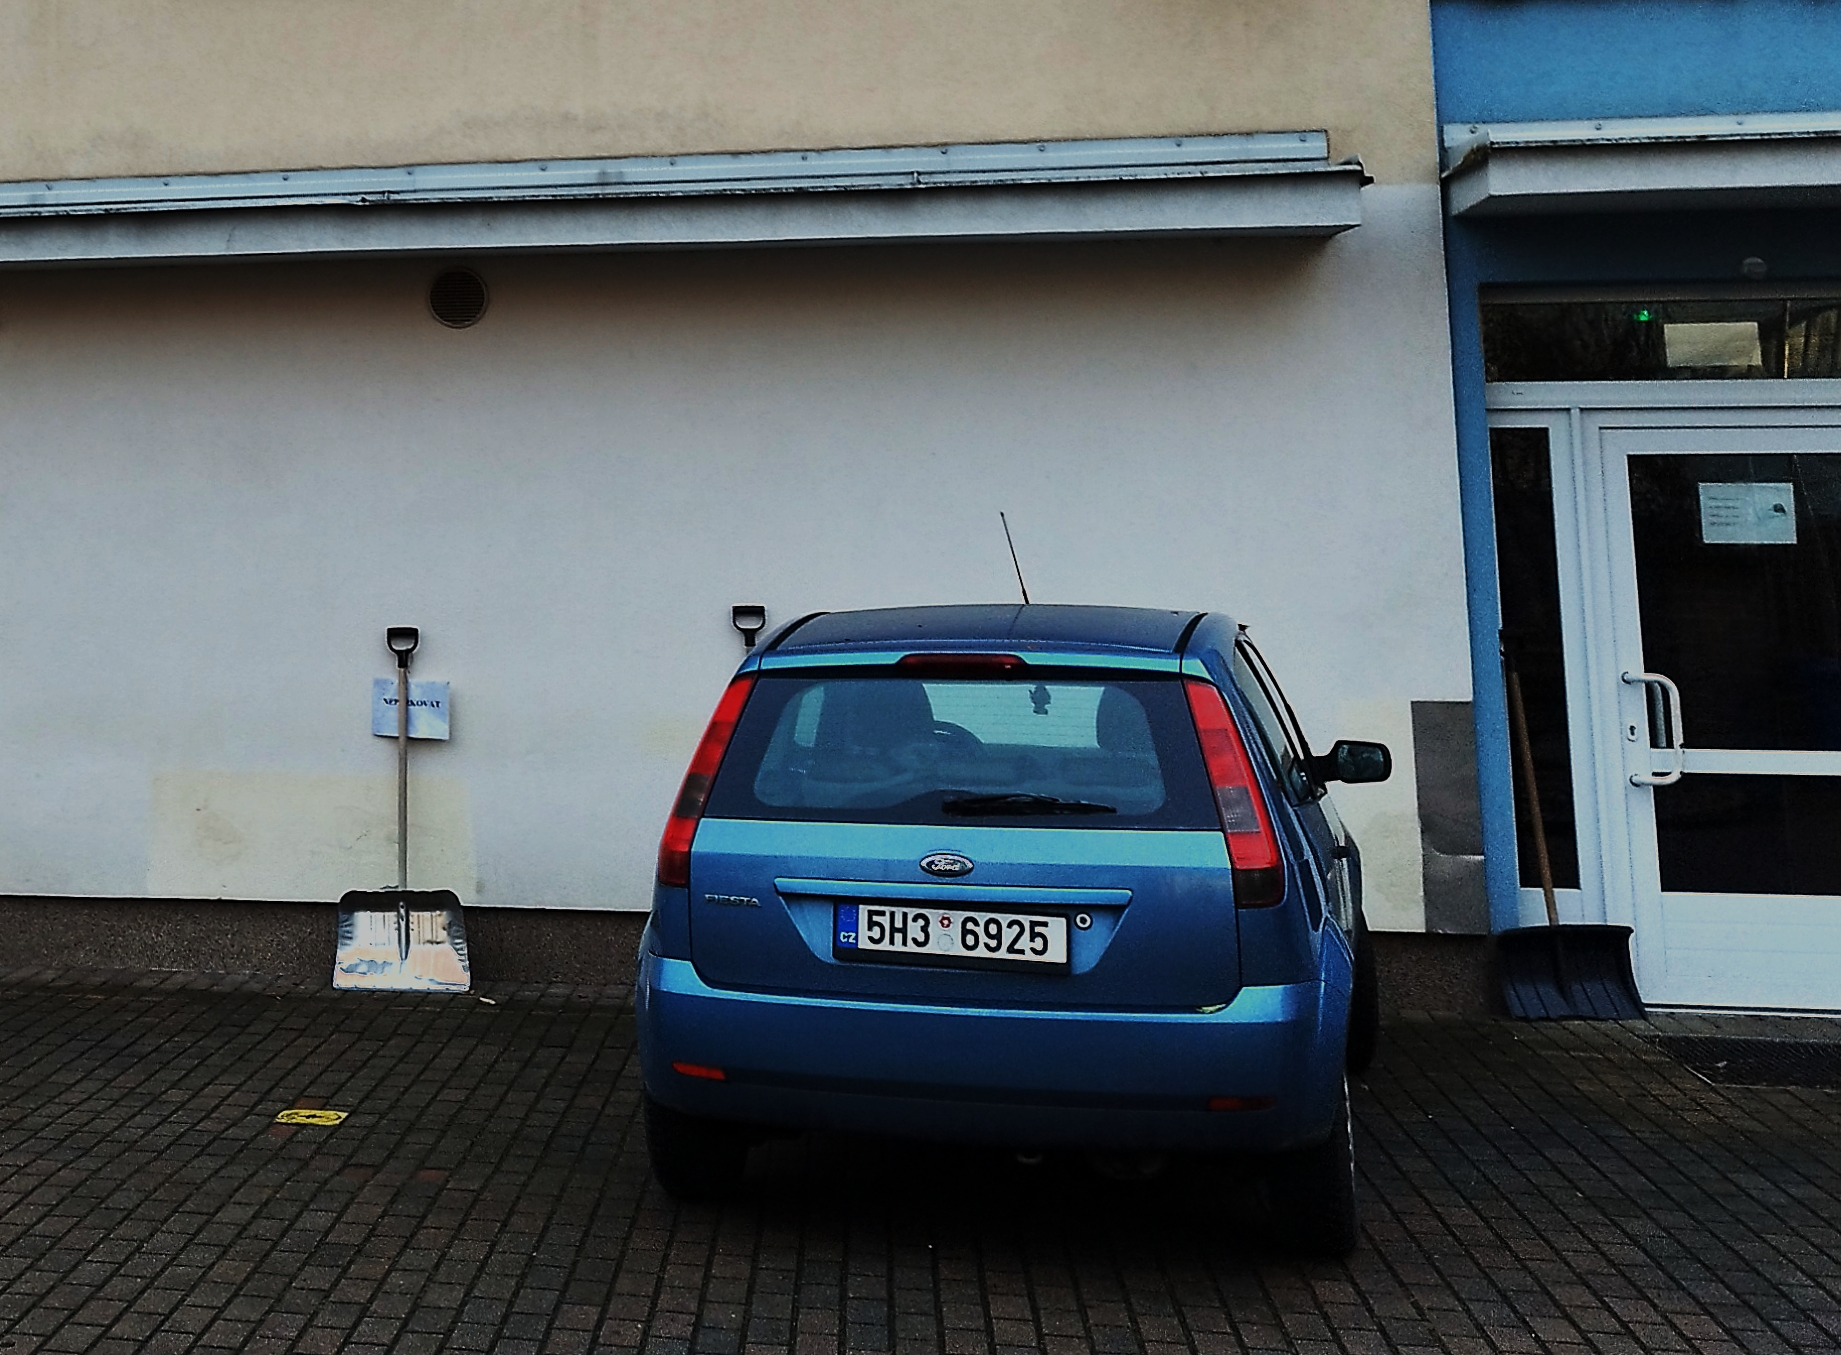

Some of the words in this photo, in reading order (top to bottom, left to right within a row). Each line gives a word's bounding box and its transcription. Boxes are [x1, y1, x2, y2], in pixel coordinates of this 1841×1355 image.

[704, 893, 762, 907] FIESTA
[839, 931, 857, 944] CZ
[866, 909, 931, 948] 5H3
[960, 915, 1049, 957] 6925
